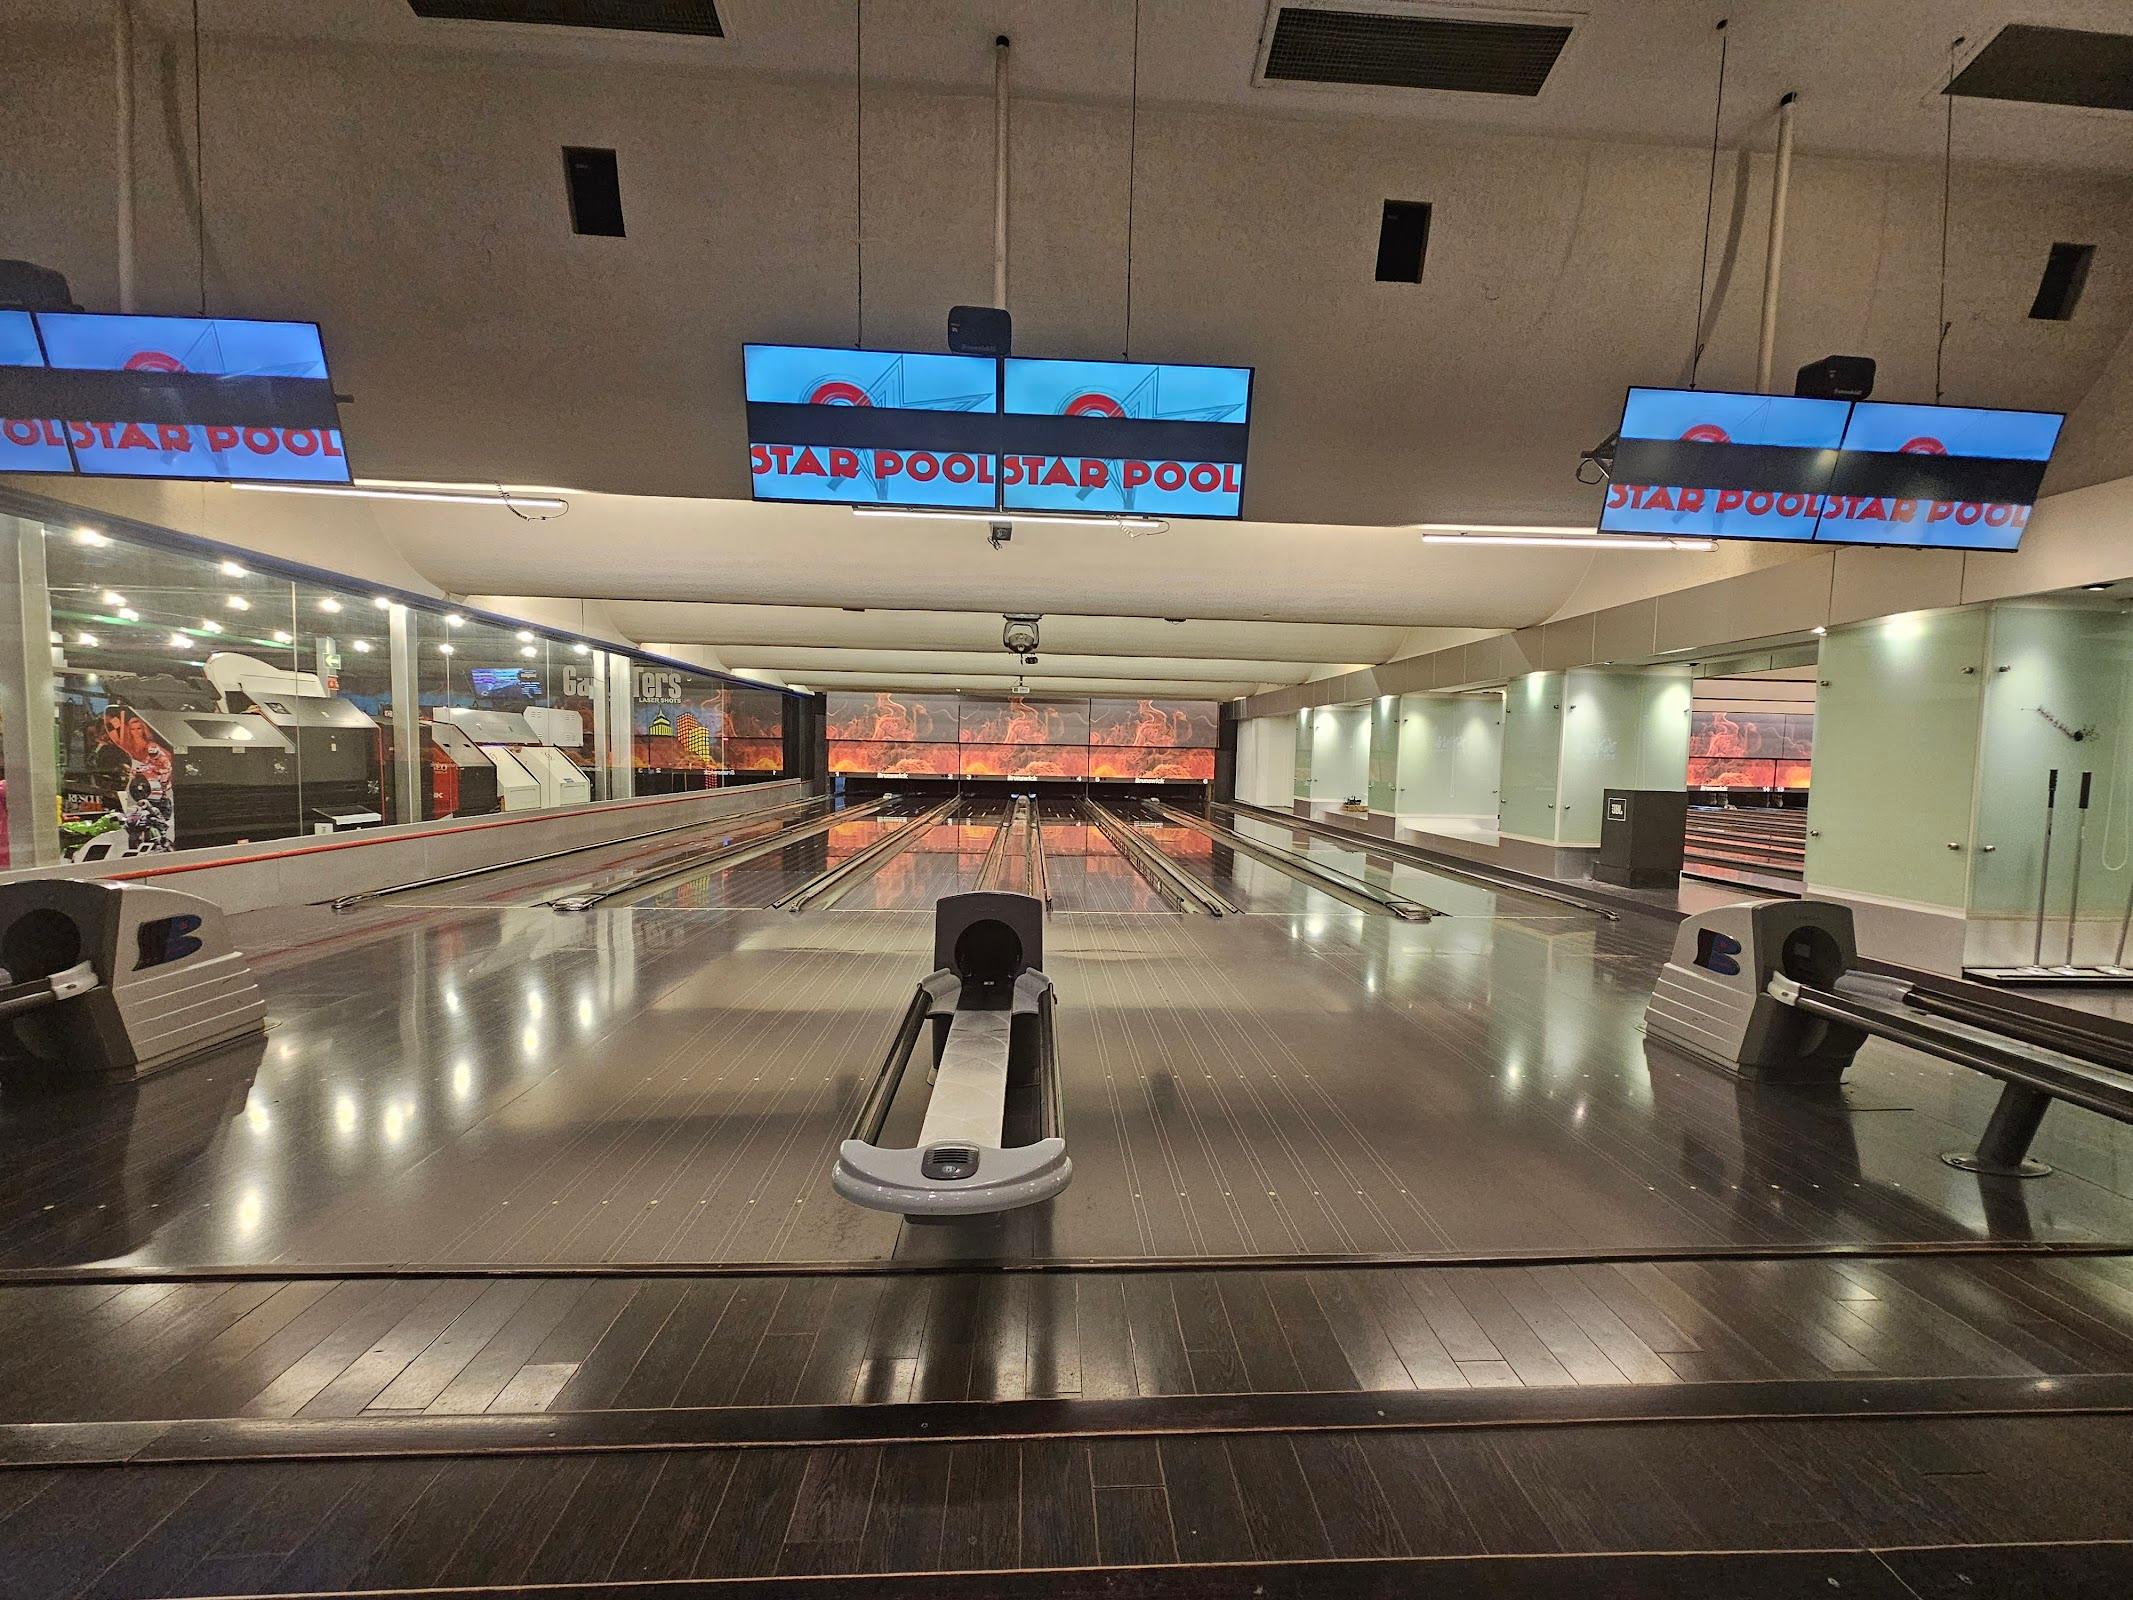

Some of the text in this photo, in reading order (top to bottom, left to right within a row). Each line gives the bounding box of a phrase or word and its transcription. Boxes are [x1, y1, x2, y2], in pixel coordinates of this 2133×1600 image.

[3, 419, 66, 446] OL
[69, 420, 342, 457] STAR POOL
[751, 445, 995, 483] STAR POOL
[1003, 456, 1239, 492] STAR POOL
[1607, 484, 1820, 518] STAR POOL
[1823, 495, 2030, 528] STAR POOL
